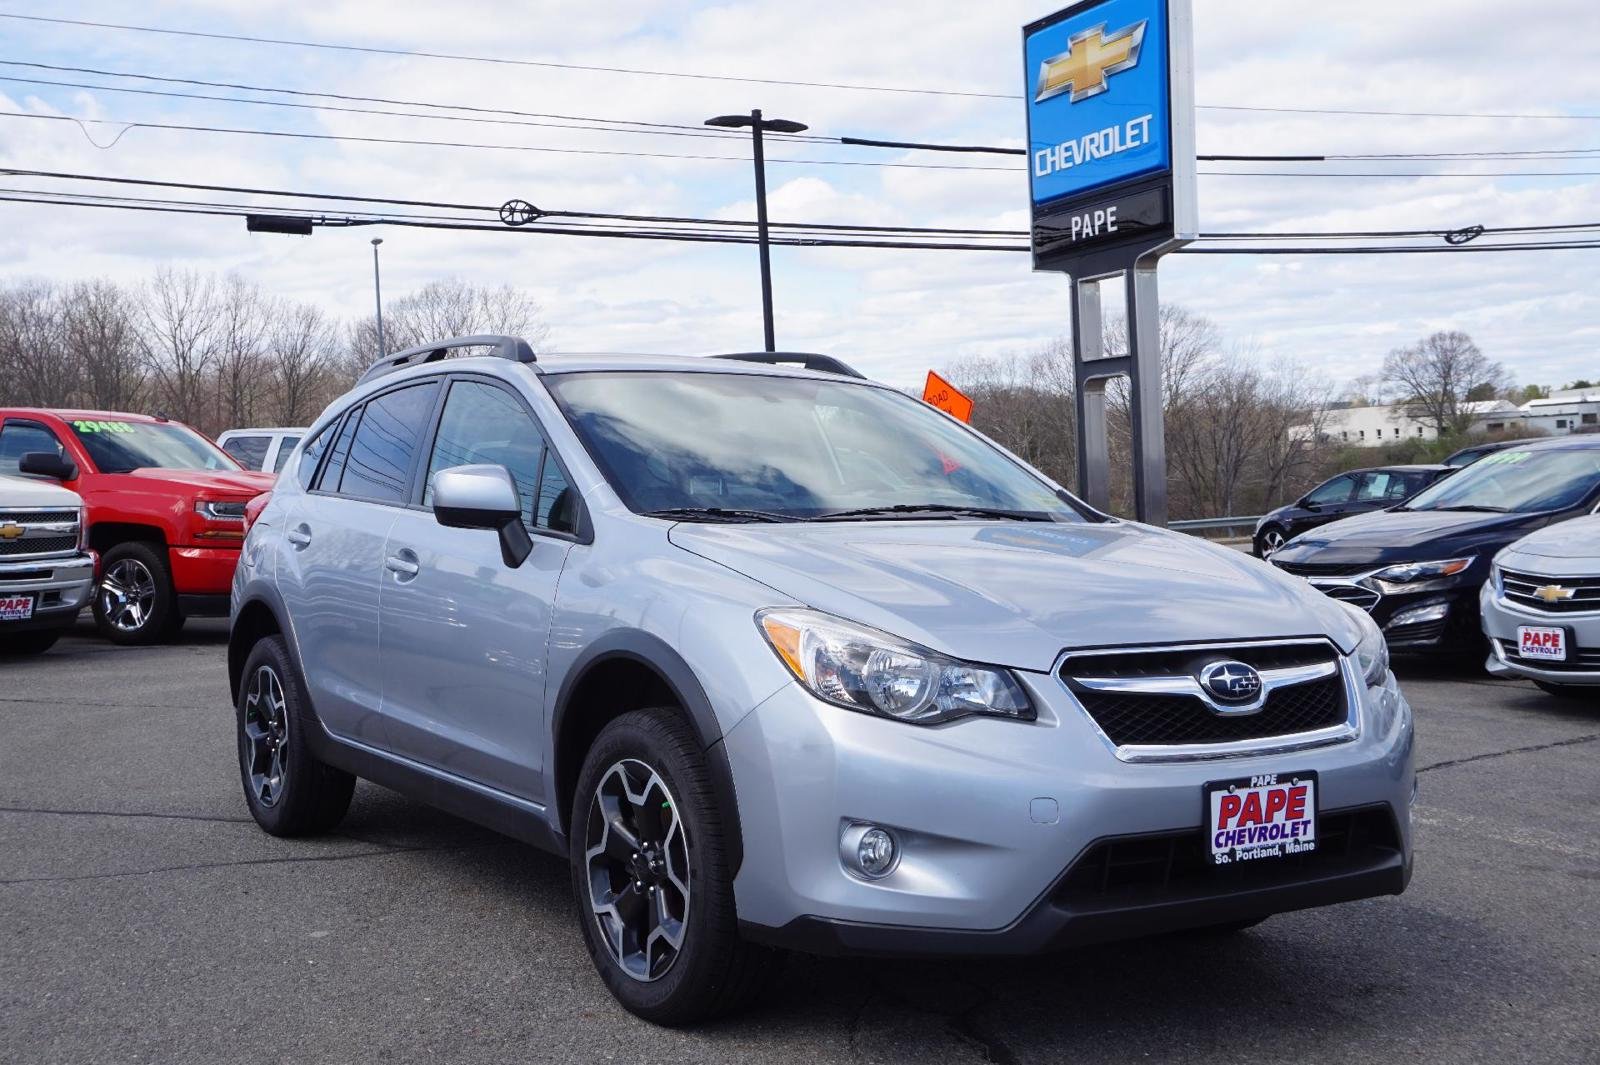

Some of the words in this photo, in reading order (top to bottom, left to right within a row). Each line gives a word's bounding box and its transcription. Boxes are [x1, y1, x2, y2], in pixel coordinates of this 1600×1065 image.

[1034, 114, 1152, 177] CHEVROLET
[1071, 206, 1118, 241] PAPE
[0, 599, 31, 609] PAPE
[1522, 646, 1563, 655] CHEVROLET
[1523, 632, 1561, 648] PAPE
[1250, 774, 1278, 788] PAPE
[1217, 786, 1308, 830] PAPE
[1214, 820, 1312, 848] CHEVROLET
[1215, 852, 1232, 865] So.
[1236, 844, 1282, 862] Portland,
[1285, 841, 1315, 855] Maine
